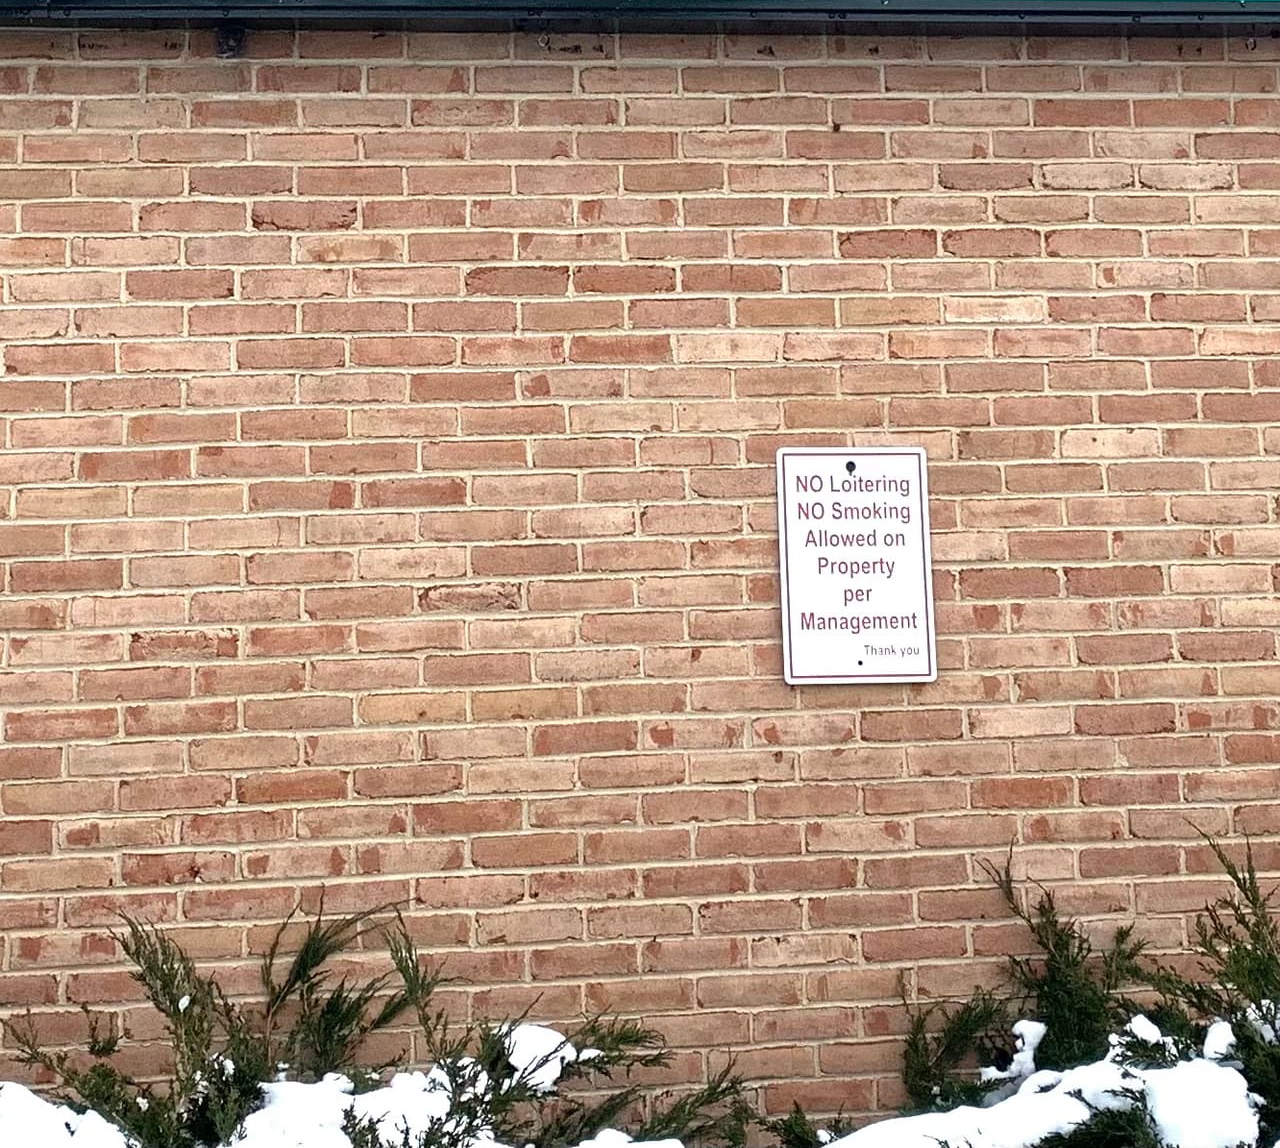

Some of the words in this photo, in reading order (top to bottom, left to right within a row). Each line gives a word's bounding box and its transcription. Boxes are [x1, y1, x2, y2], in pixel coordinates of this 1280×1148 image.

[796, 475, 823, 492] NO
[830, 475, 910, 496] Loitering
[798, 503, 824, 520] NO
[832, 502, 910, 524] Smoking
[805, 530, 876, 547] Allowed
[884, 533, 905, 546] on
[818, 557, 895, 578] Property
[844, 588, 872, 606] per
[801, 612, 917, 634] Management
[864, 645, 897, 656] Thank
[901, 646, 920, 657] you
